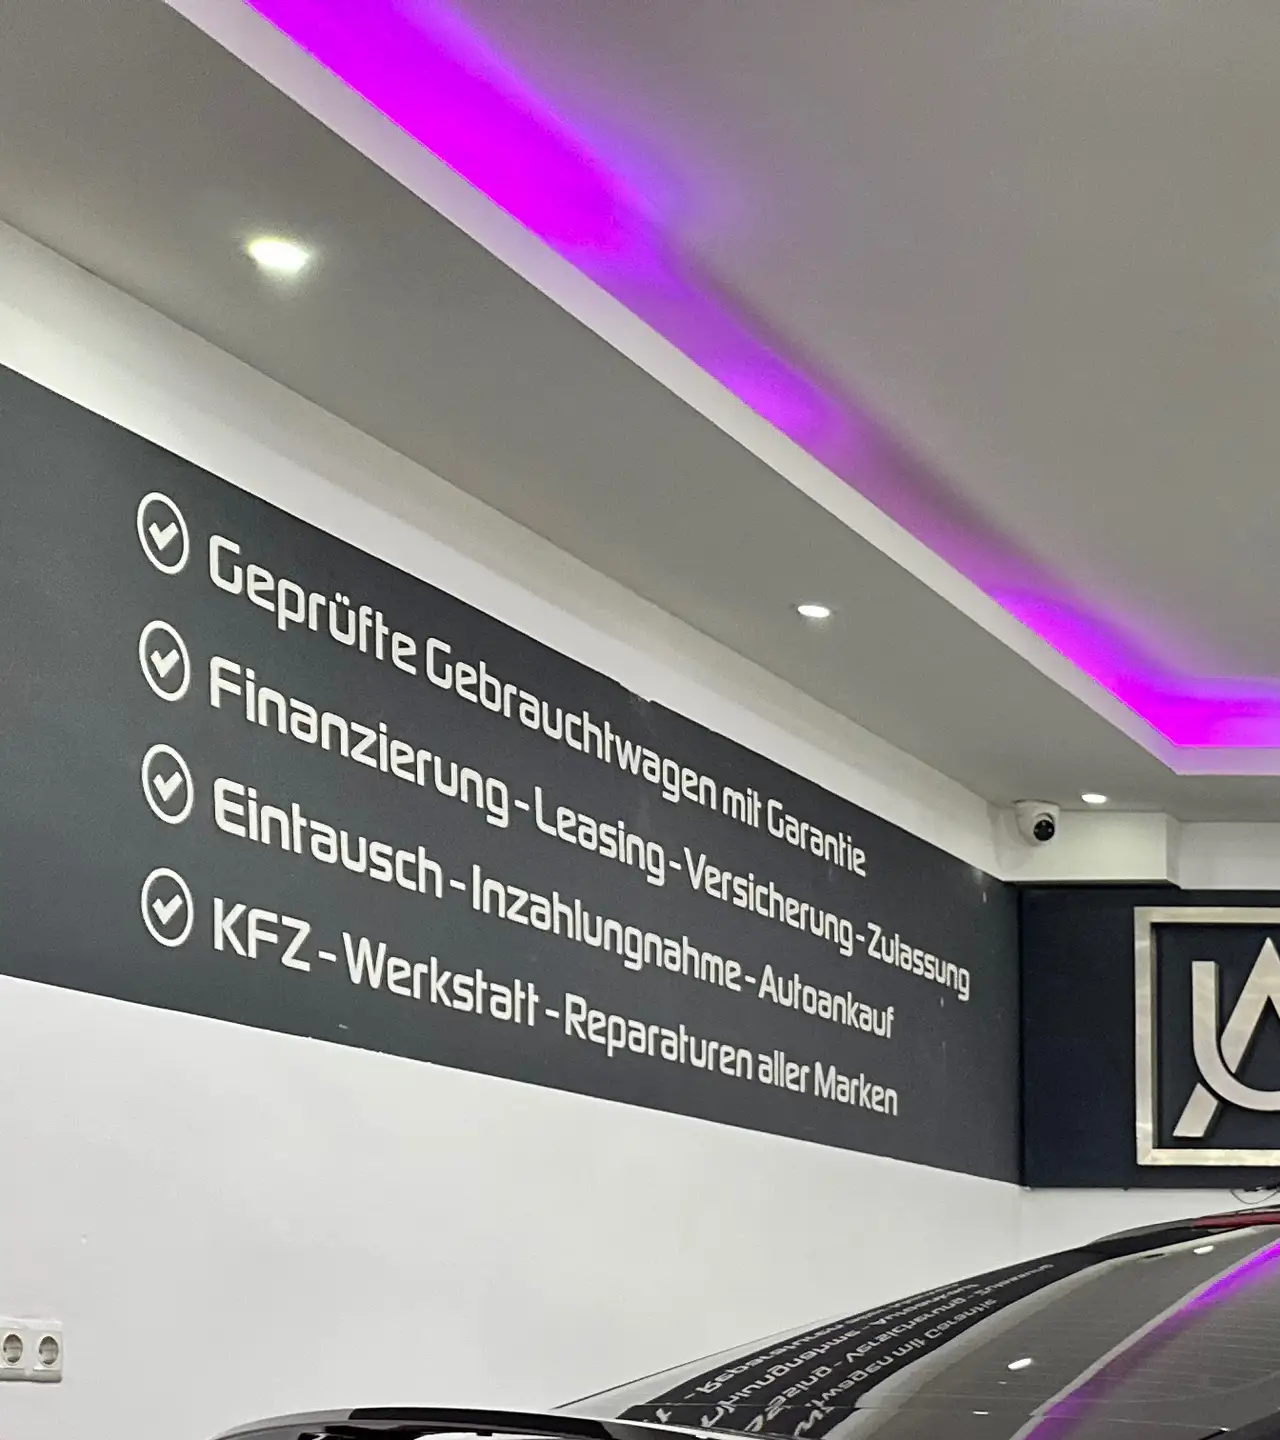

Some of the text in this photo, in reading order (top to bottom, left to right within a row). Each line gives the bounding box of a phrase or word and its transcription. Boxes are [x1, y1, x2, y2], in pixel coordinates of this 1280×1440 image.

[210, 535, 866, 877] Geprüfte Gebrauchtwagen mit Garantie
[210, 656, 509, 828] Finanzierung
[535, 787, 665, 886] Leasing
[684, 847, 854, 957] Versicherung
[868, 923, 970, 1002] Zulassung
[213, 777, 442, 898] Eintausch
[473, 865, 742, 991] Inzahlungnahme
[758, 965, 895, 1039] Autoankauf
[213, 897, 311, 972] KFZ
[343, 932, 540, 1027] Werkstatt
[565, 993, 753, 1079] Reparaturen
[758, 1050, 811, 1093] aller
[814, 1061, 898, 1116] Marken
